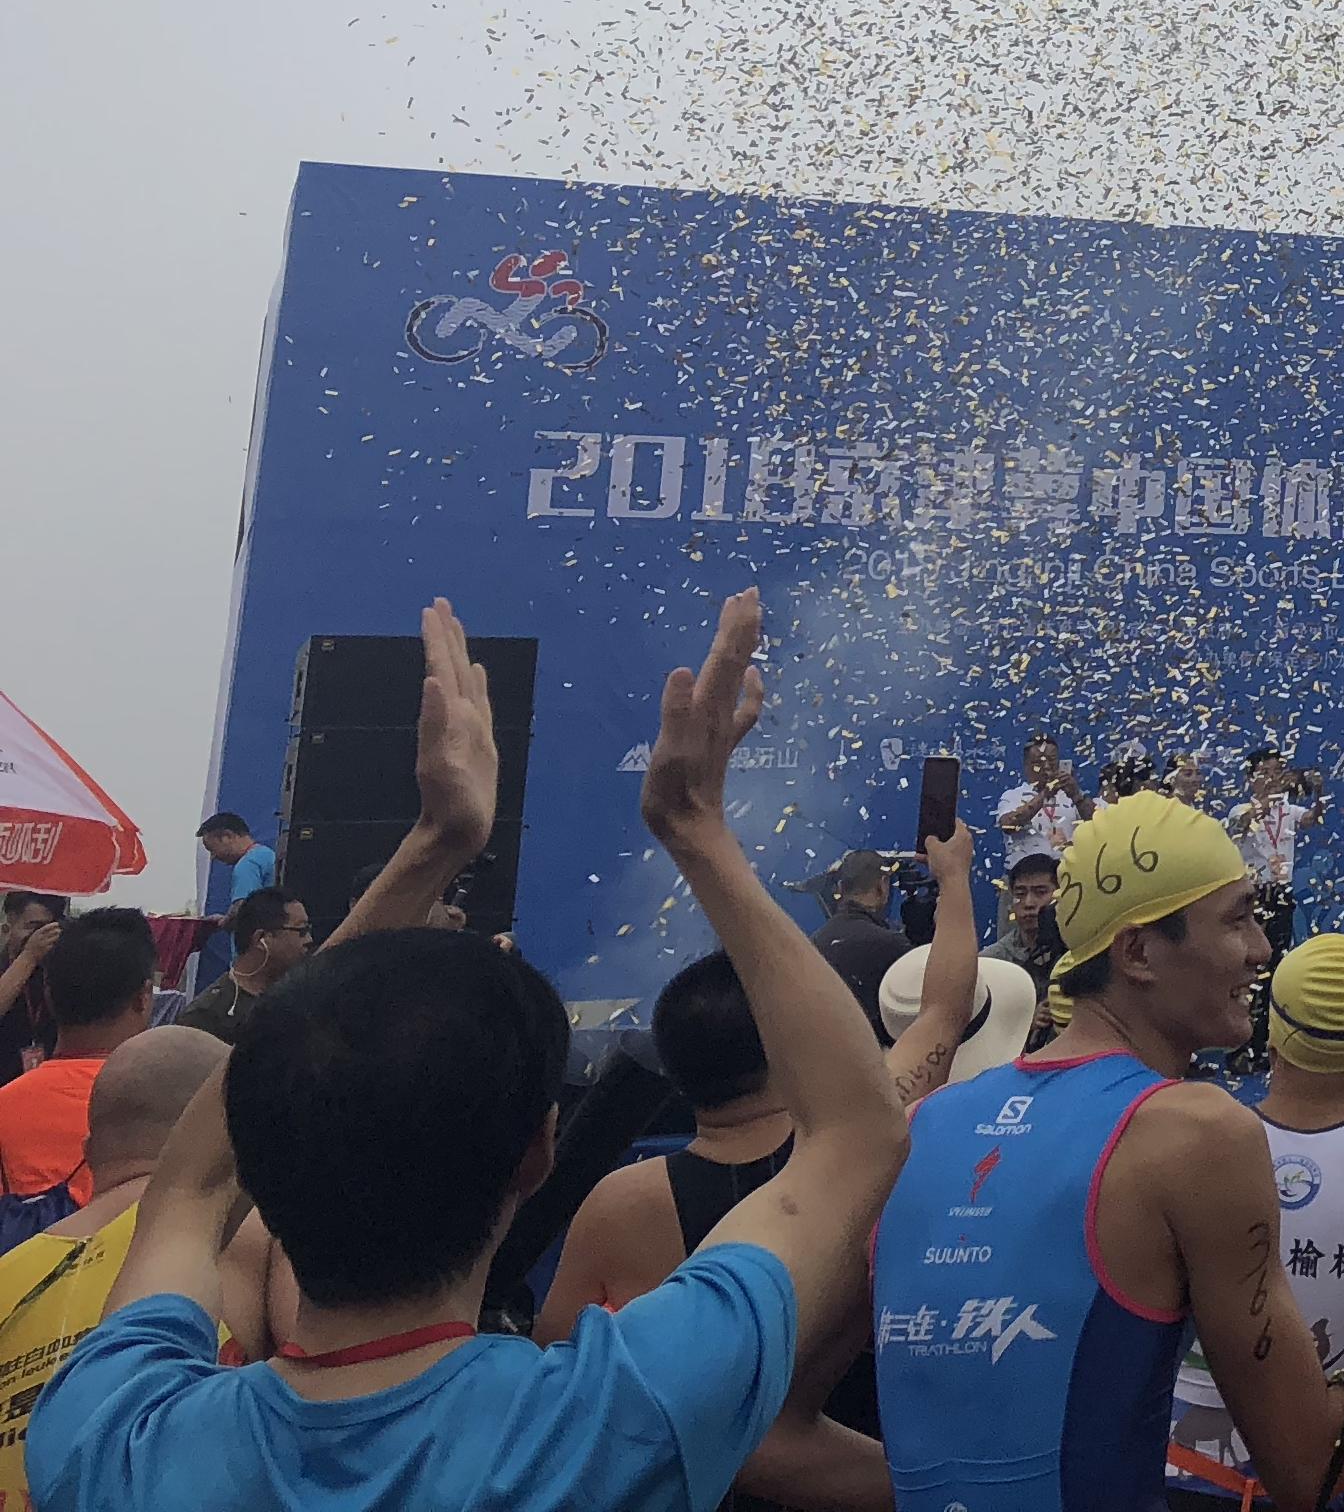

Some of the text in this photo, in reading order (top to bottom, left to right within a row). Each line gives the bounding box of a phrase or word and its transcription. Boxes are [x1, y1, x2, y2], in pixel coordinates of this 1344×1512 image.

[1060, 825, 1160, 928] 366
[923, 1245, 993, 1265] SUUNTO
[907, 1341, 988, 1360] TRIATHLON
